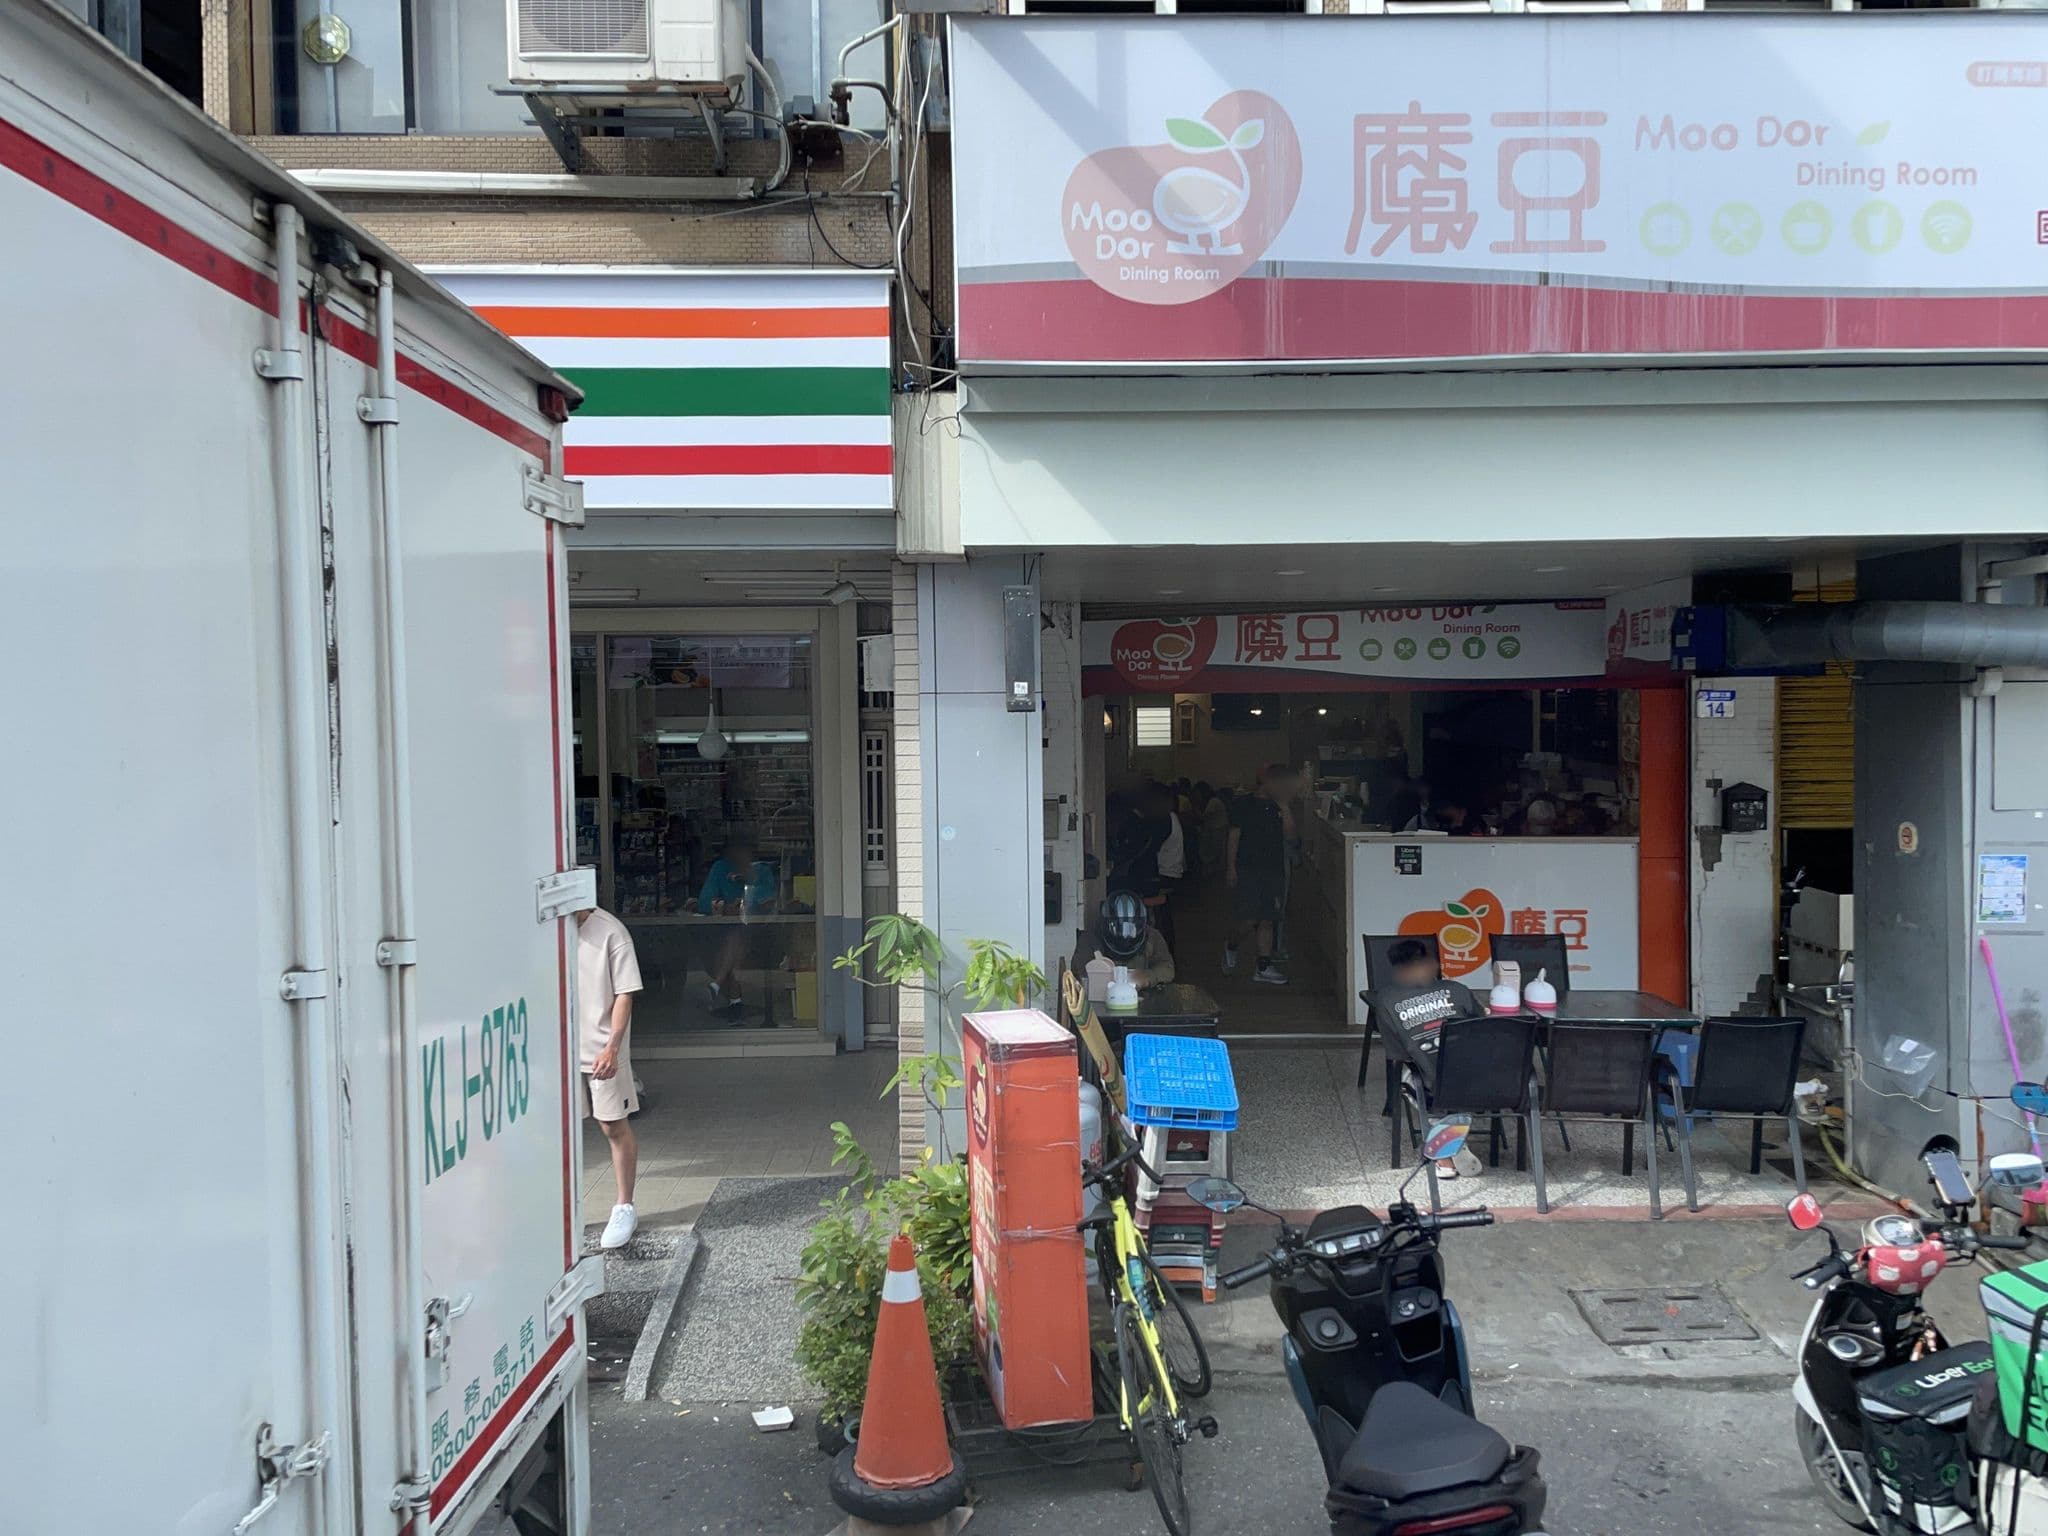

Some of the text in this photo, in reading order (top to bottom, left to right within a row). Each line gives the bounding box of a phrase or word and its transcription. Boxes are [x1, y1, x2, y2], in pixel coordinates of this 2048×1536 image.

[1635, 113, 1830, 153] Moo Dor
[1343, 99, 1609, 258] 魔豆
[1796, 161, 1978, 192] Dining Room
[1070, 200, 1153, 233] Moo
[1095, 234, 1153, 262] Dor
[1119, 265, 1220, 284] Dining Room
[1443, 622, 1521, 635] Dining Room
[1116, 648, 1152, 661] Moo
[1127, 660, 1152, 672] Dor
[1706, 702, 1725, 717] 14
[1399, 998, 1454, 1021] ORIGINAL
[423, 996, 531, 1186] KLJ-8763
[431, 1315, 535, 1454] 服務電話
[1914, 1365, 1968, 1388] Uber
[431, 1343, 536, 1482] 0800-008711
